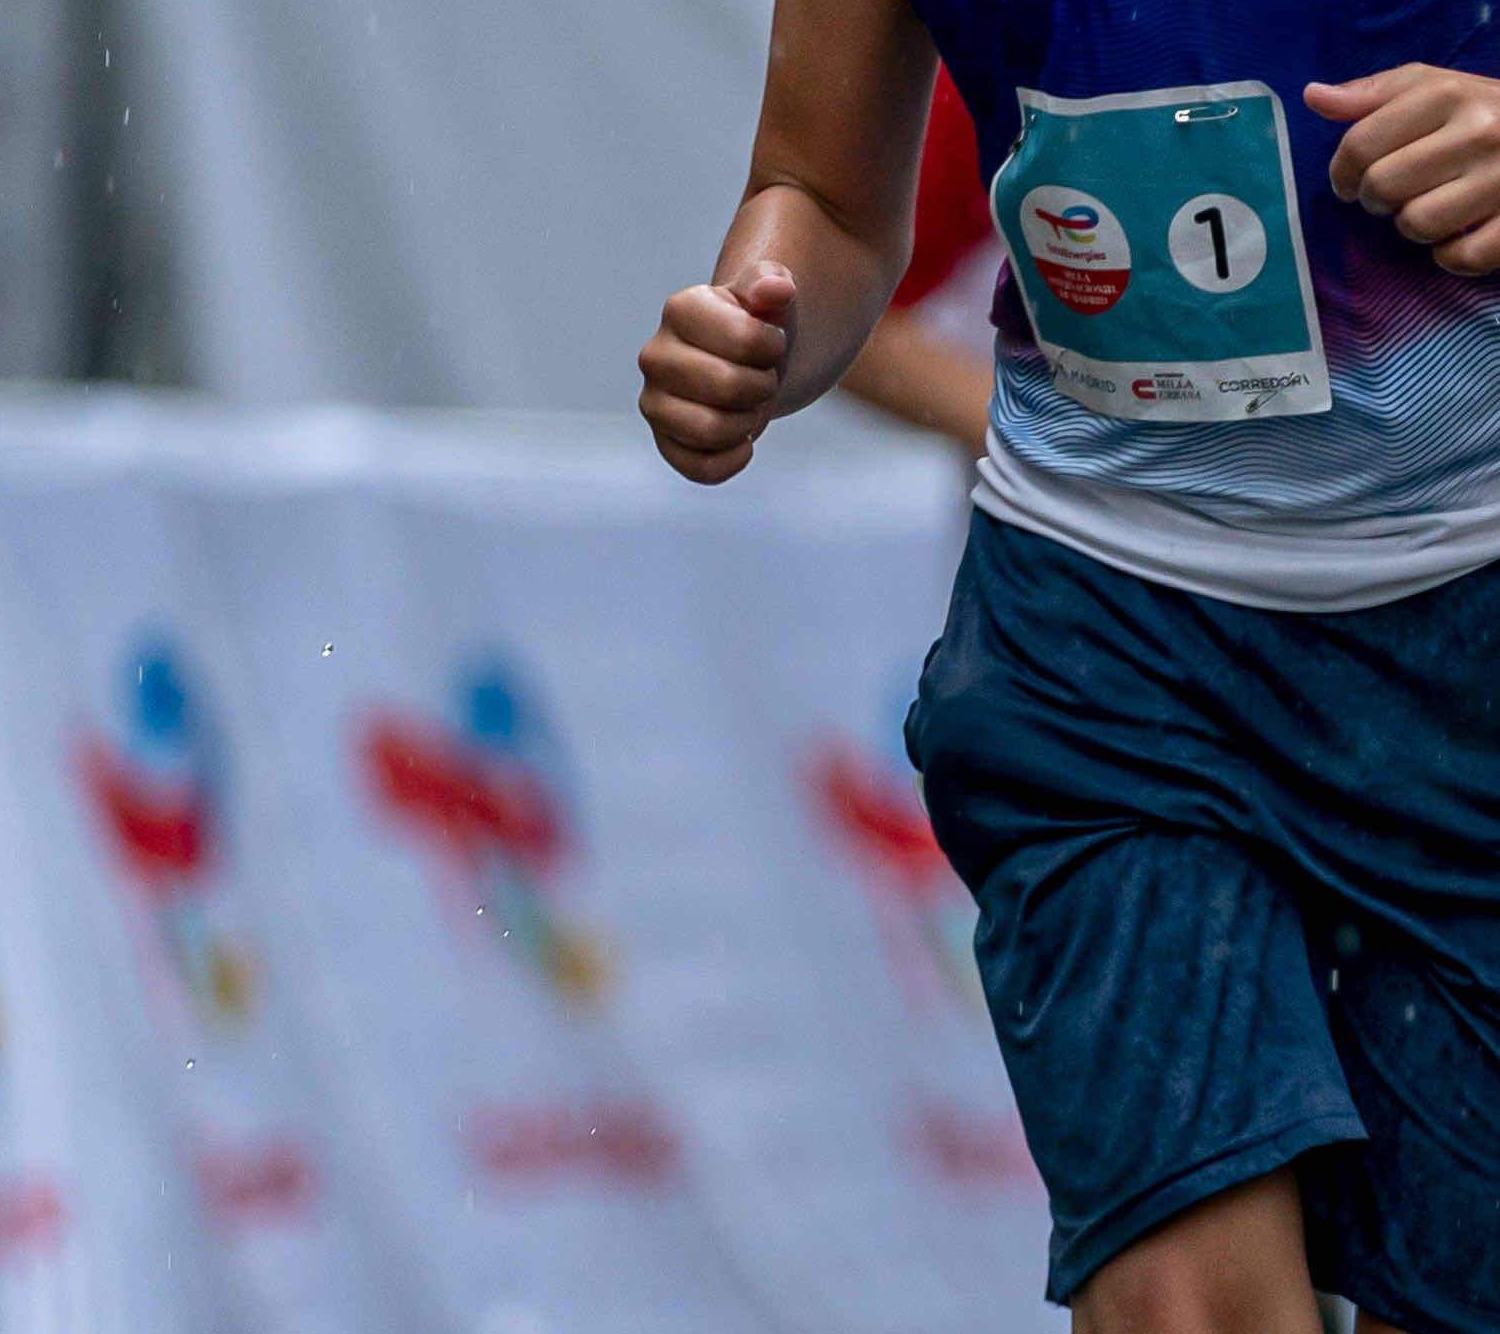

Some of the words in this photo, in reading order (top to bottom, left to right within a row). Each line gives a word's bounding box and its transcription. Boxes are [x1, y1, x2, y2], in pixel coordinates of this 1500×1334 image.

[1193, 207, 1230, 280] 1
[1156, 378, 1195, 390] MILLA
[1157, 390, 1202, 401] URBANA
